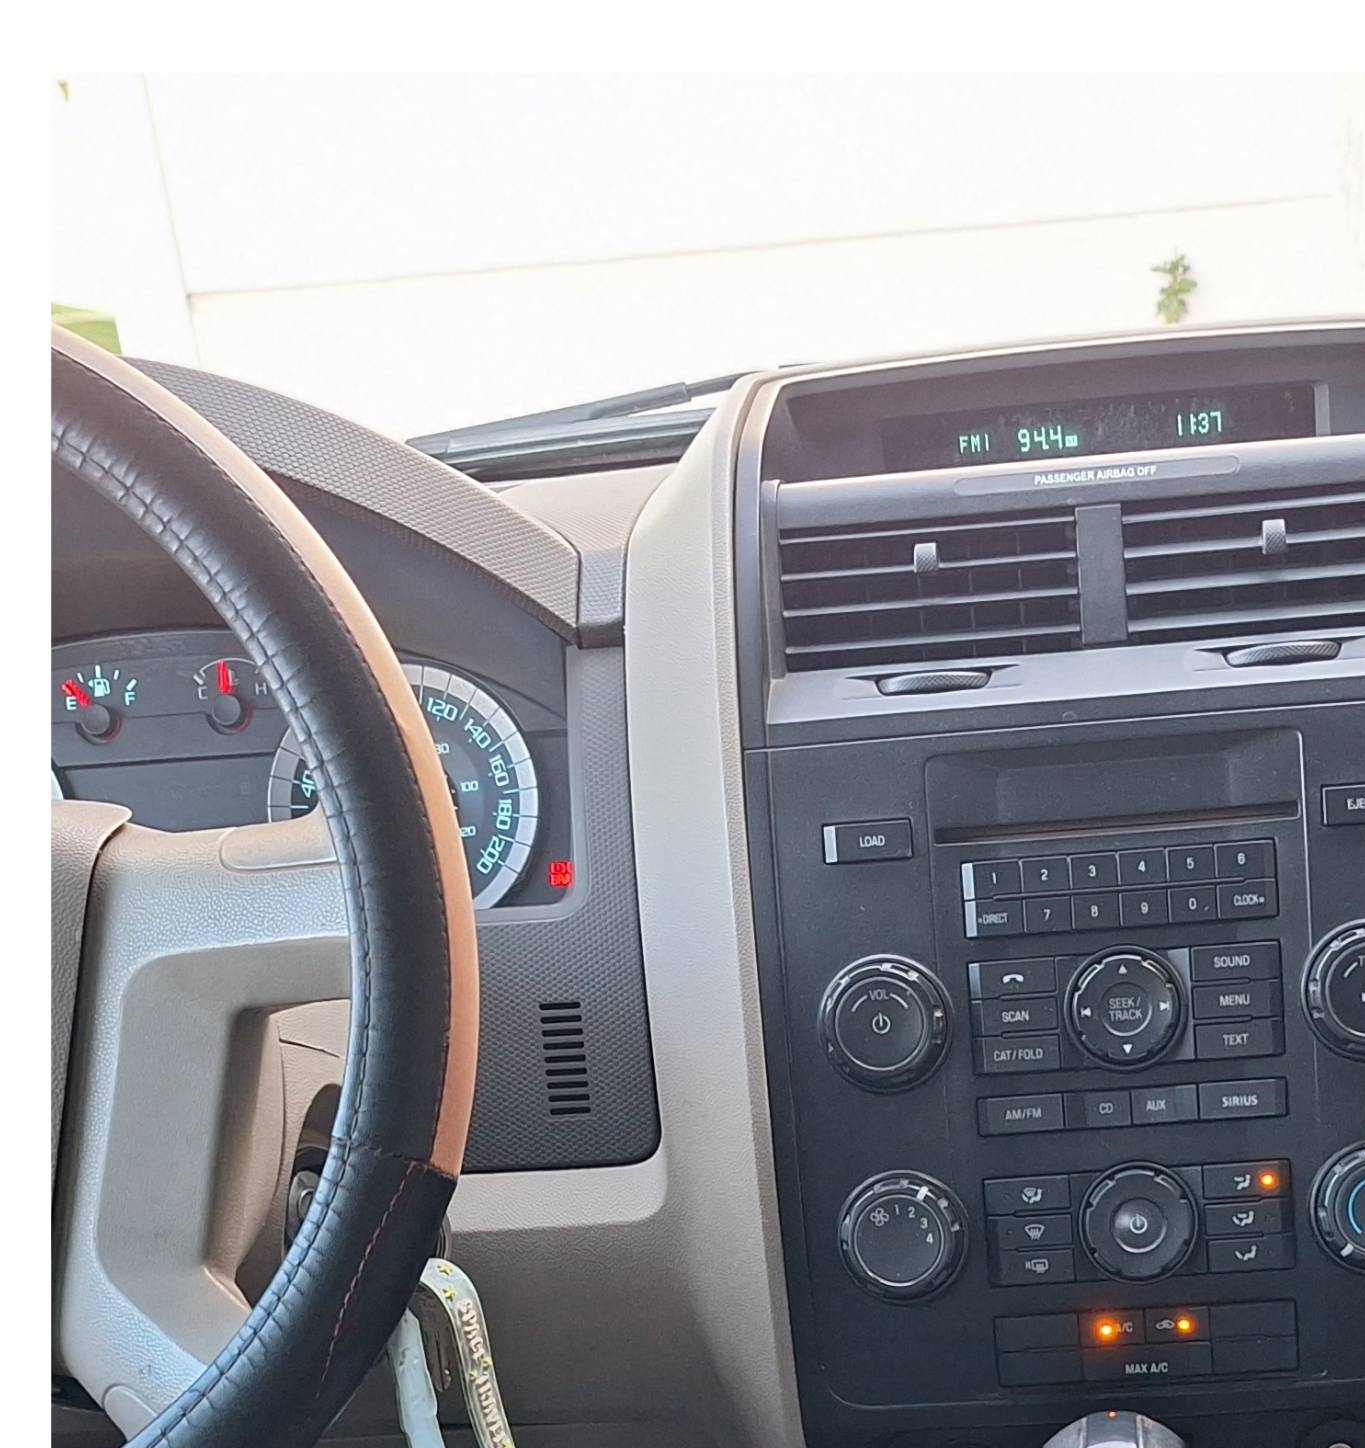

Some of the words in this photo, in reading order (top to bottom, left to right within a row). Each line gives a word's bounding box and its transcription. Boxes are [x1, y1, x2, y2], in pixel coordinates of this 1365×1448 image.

[1177, 411, 1222, 436] 11:37
[1034, 470, 1095, 485] PASSENGER
[1096, 467, 1135, 479] AIRBAG
[1136, 465, 1157, 477] OFF
[255, 683, 268, 695] H
[66, 697, 77, 710] E
[125, 691, 135, 705] F
[426, 697, 458, 722] 120
[464, 718, 491, 750] 140
[488, 754, 510, 787] 160
[460, 781, 479, 792] 100
[496, 798, 512, 831] 180
[859, 835, 885, 847] LOAD
[476, 835, 506, 875] 200
[1238, 852, 1246, 865] 6
[1138, 860, 1146, 873] 4
[1186, 857, 1194, 870] 5
[1041, 869, 1049, 881] 2
[1089, 865, 1097, 877] 3
[992, 872, 997, 884] 1
[1141, 902, 1149, 914] 9
[1189, 898, 1197, 910] 0
[1043, 909, 1051, 921] 7
[1091, 905, 1098, 917] 8
[1213, 955, 1250, 968] SOUND
[869, 989, 890, 1000] VOL
[1219, 994, 1250, 1006] MENU
[1002, 1010, 1029, 1022] SCAN
[1109, 1008, 1143, 1021] TRACK
[1222, 1033, 1248, 1046] TEXT
[1146, 1099, 1166, 1111] AUX
[1221, 1094, 1258, 1107] SIRIUS
[1005, 1108, 1041, 1121] AM/FM
[1099, 1103, 1113, 1114] CD
[894, 1204, 899, 1215] 1
[907, 1207, 916, 1218] 2
[920, 1217, 928, 1228] 3
[926, 1233, 934, 1244] 4
[1125, 1364, 1148, 1374] MAX
[1150, 1362, 1169, 1373] A/C
